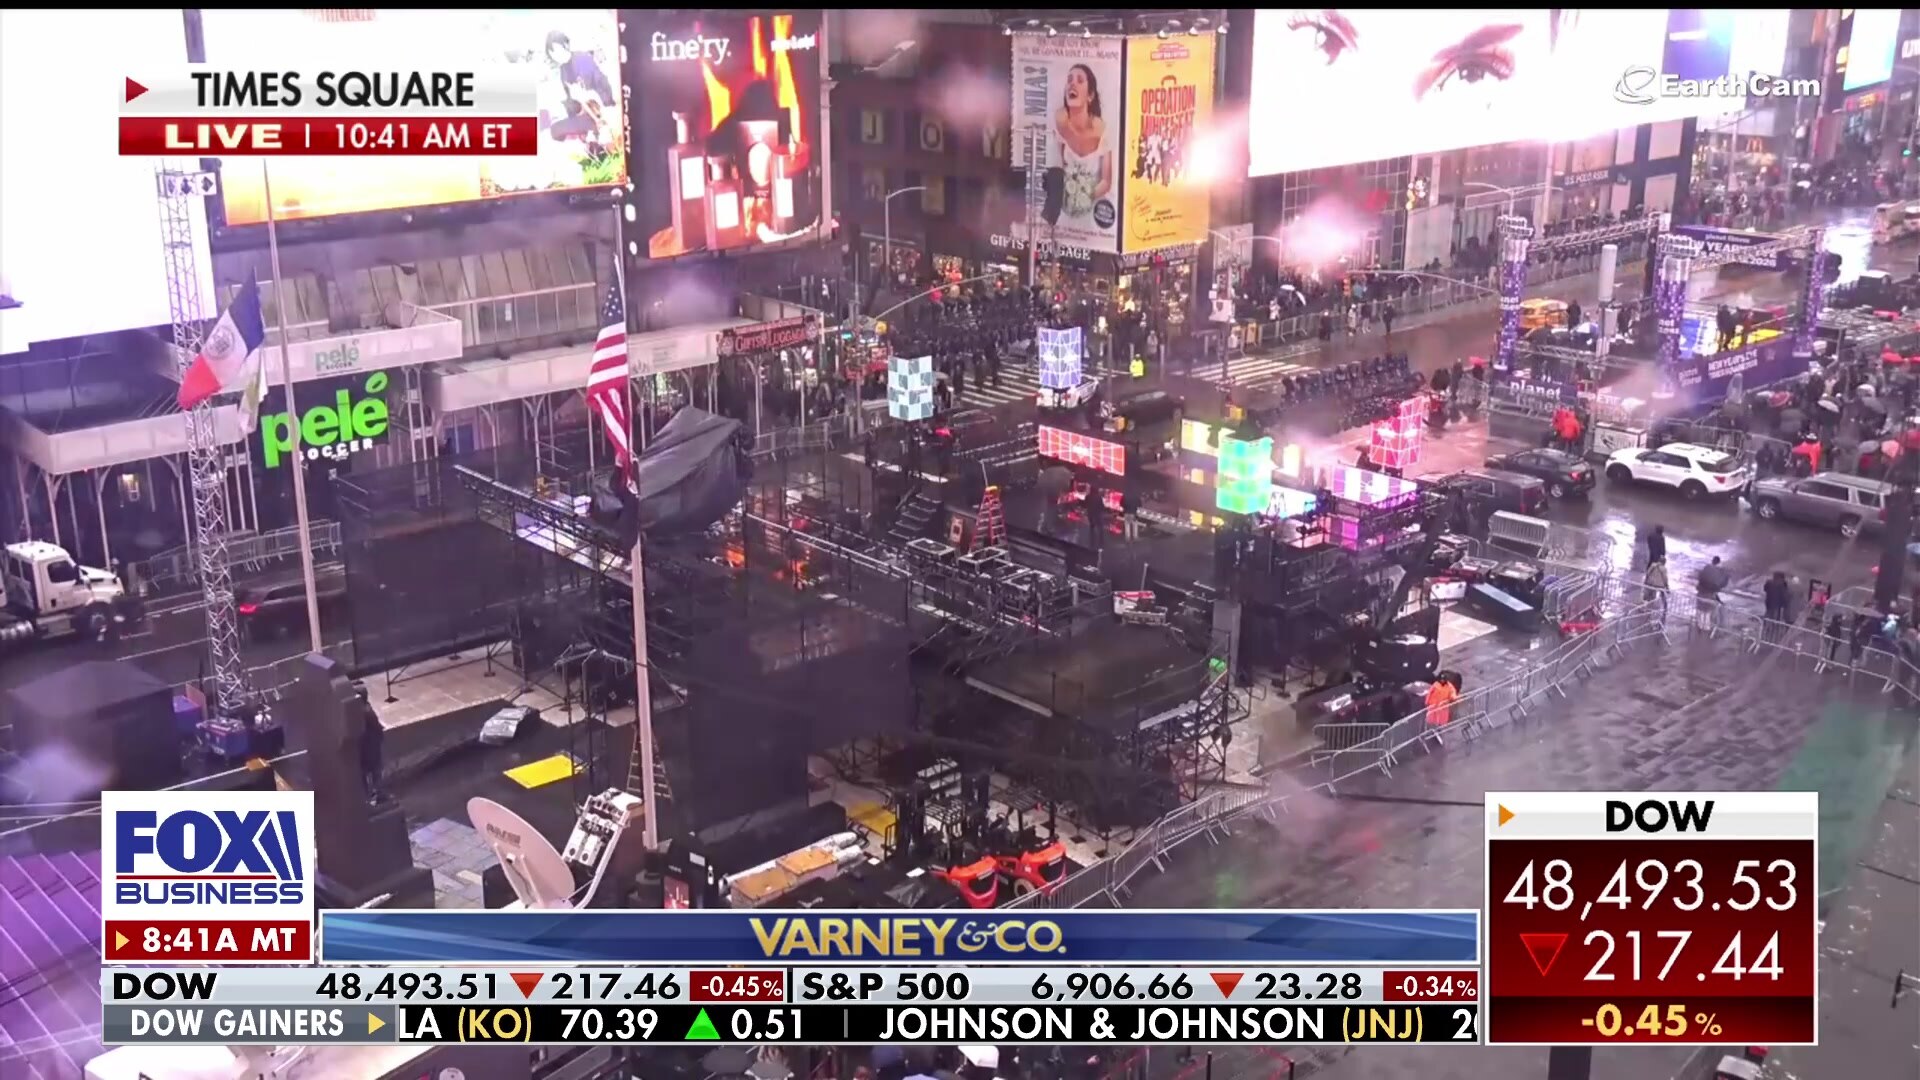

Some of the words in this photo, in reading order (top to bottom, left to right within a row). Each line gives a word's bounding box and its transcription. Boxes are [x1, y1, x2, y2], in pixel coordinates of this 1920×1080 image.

[651, 32, 731, 65] fine'ry.
[1142, 85, 1196, 115] OPERATION
[990, 234, 1024, 250] GIFTS
[1509, 379, 1561, 399] planet
[261, 371, 388, 468] pelé
